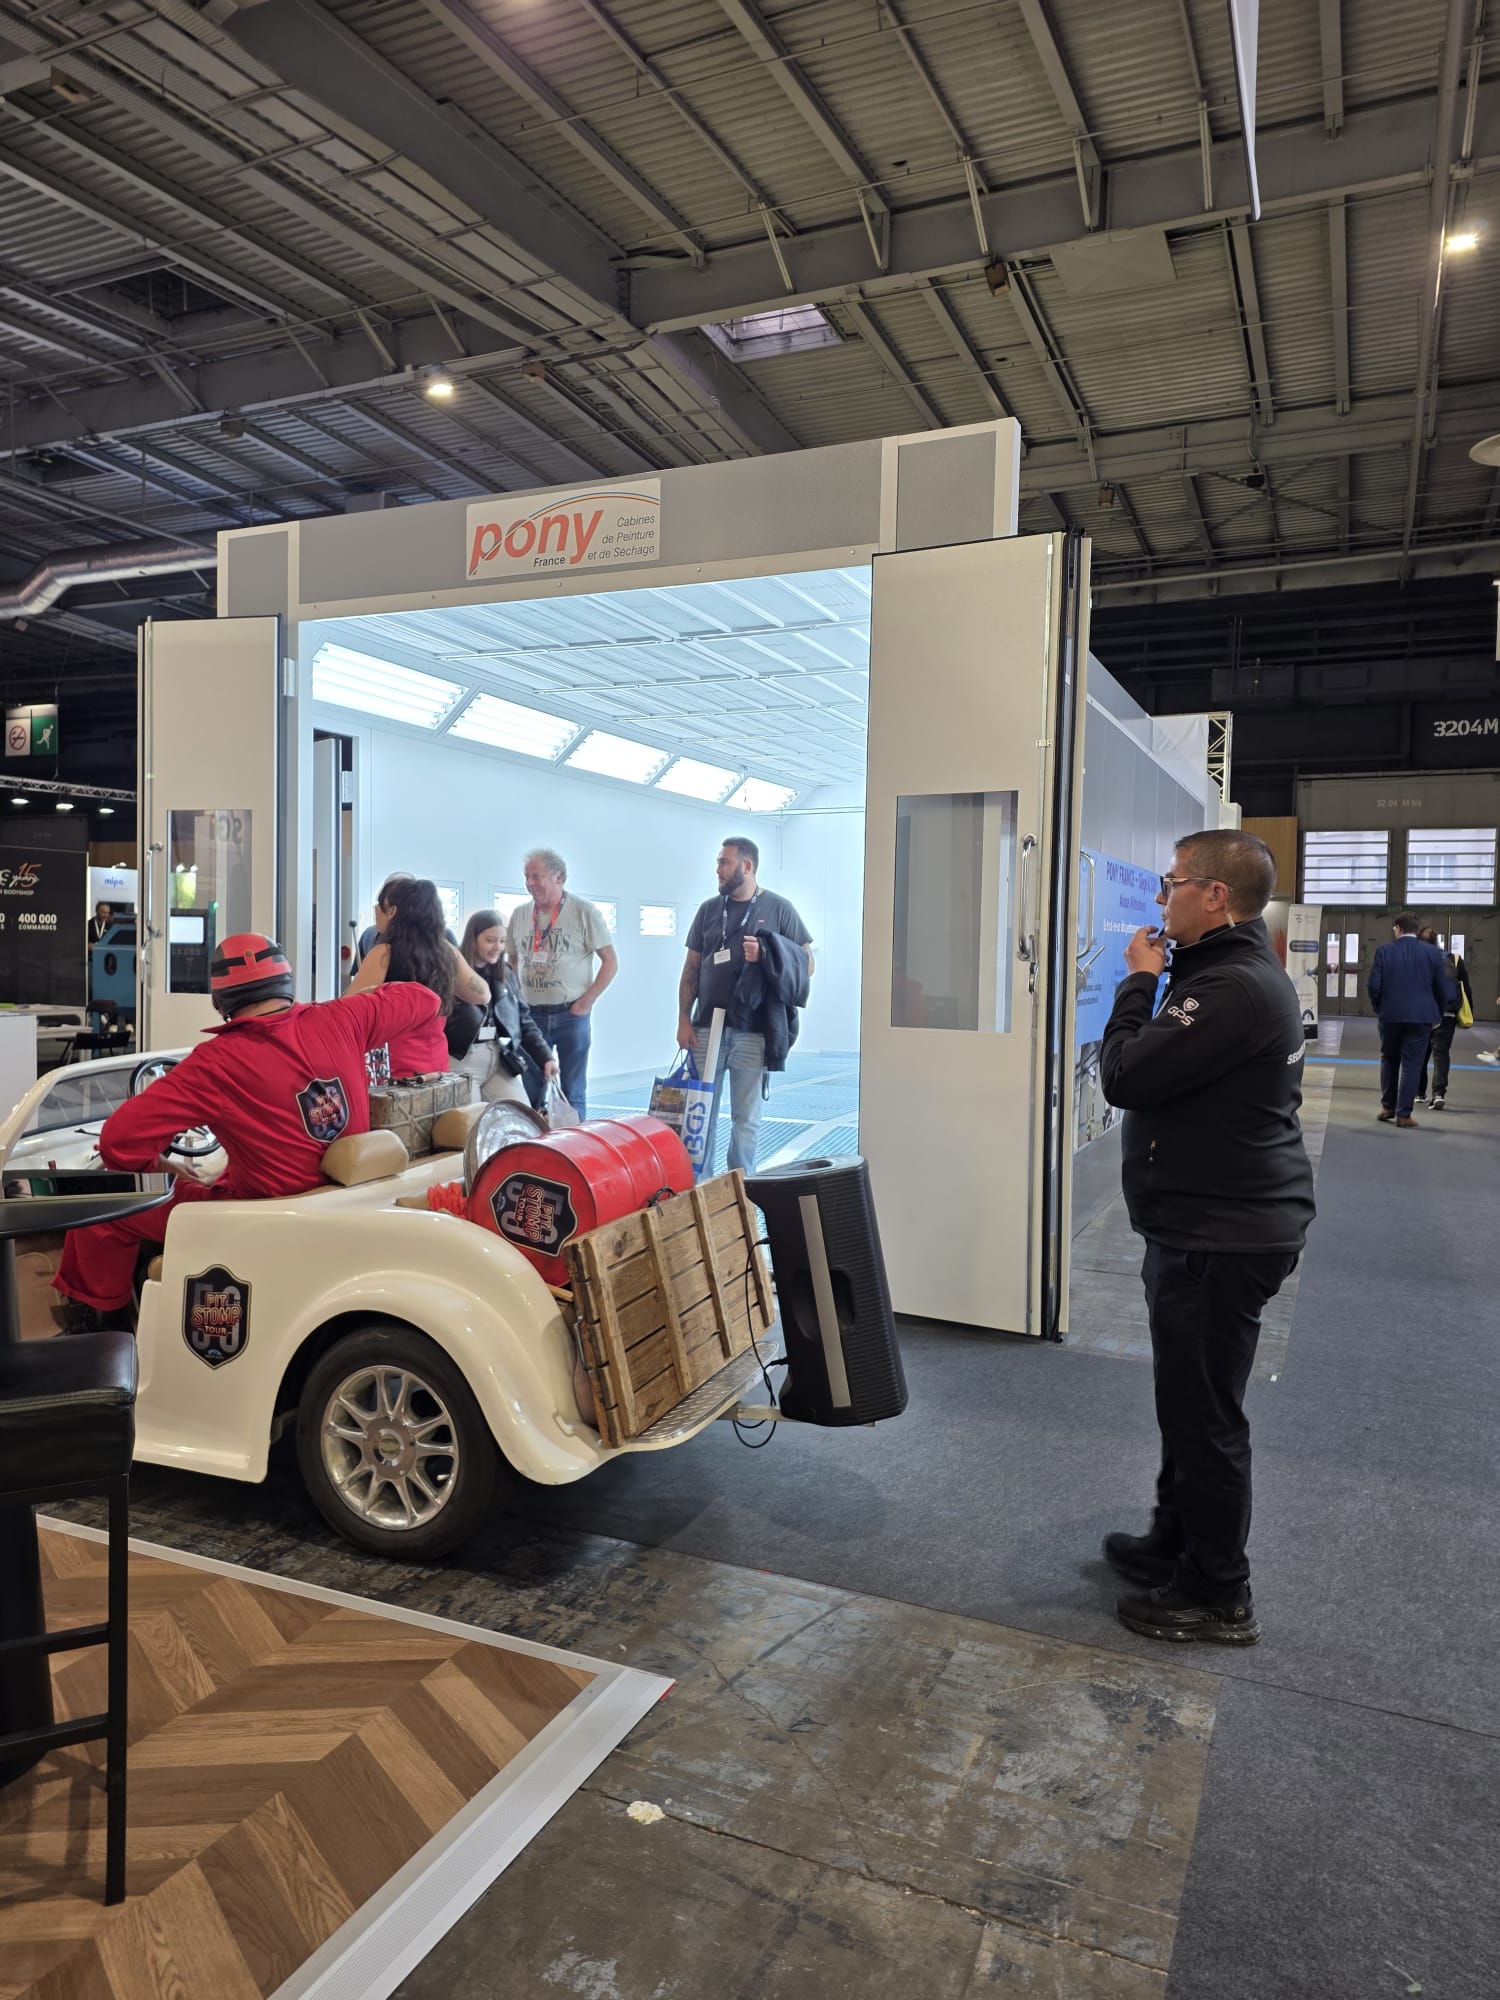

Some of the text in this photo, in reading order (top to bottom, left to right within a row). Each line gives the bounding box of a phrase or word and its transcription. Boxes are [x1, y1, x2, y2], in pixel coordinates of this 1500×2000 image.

[616, 514, 656, 528] Cabines
[469, 509, 604, 575] pony
[602, 530, 655, 545] de Peinture
[533, 555, 566, 568] France
[587, 550, 598, 561] et
[599, 547, 611, 559] de
[1120, 865, 1135, 888] FRANCE
[18, 912, 37, 924] 400
[39, 913, 57, 925] 000
[1167, 1005, 1195, 1026] GPS
[683, 1101, 706, 1156] BGS
[516, 1196, 526, 1222] TOUR
[523, 1184, 544, 1243] STOMP
[541, 1203, 554, 1231] PIT
[206, 1292, 228, 1307] PIT
[191, 1304, 242, 1328] STOMP
[204, 1326, 228, 1337] TOUR
